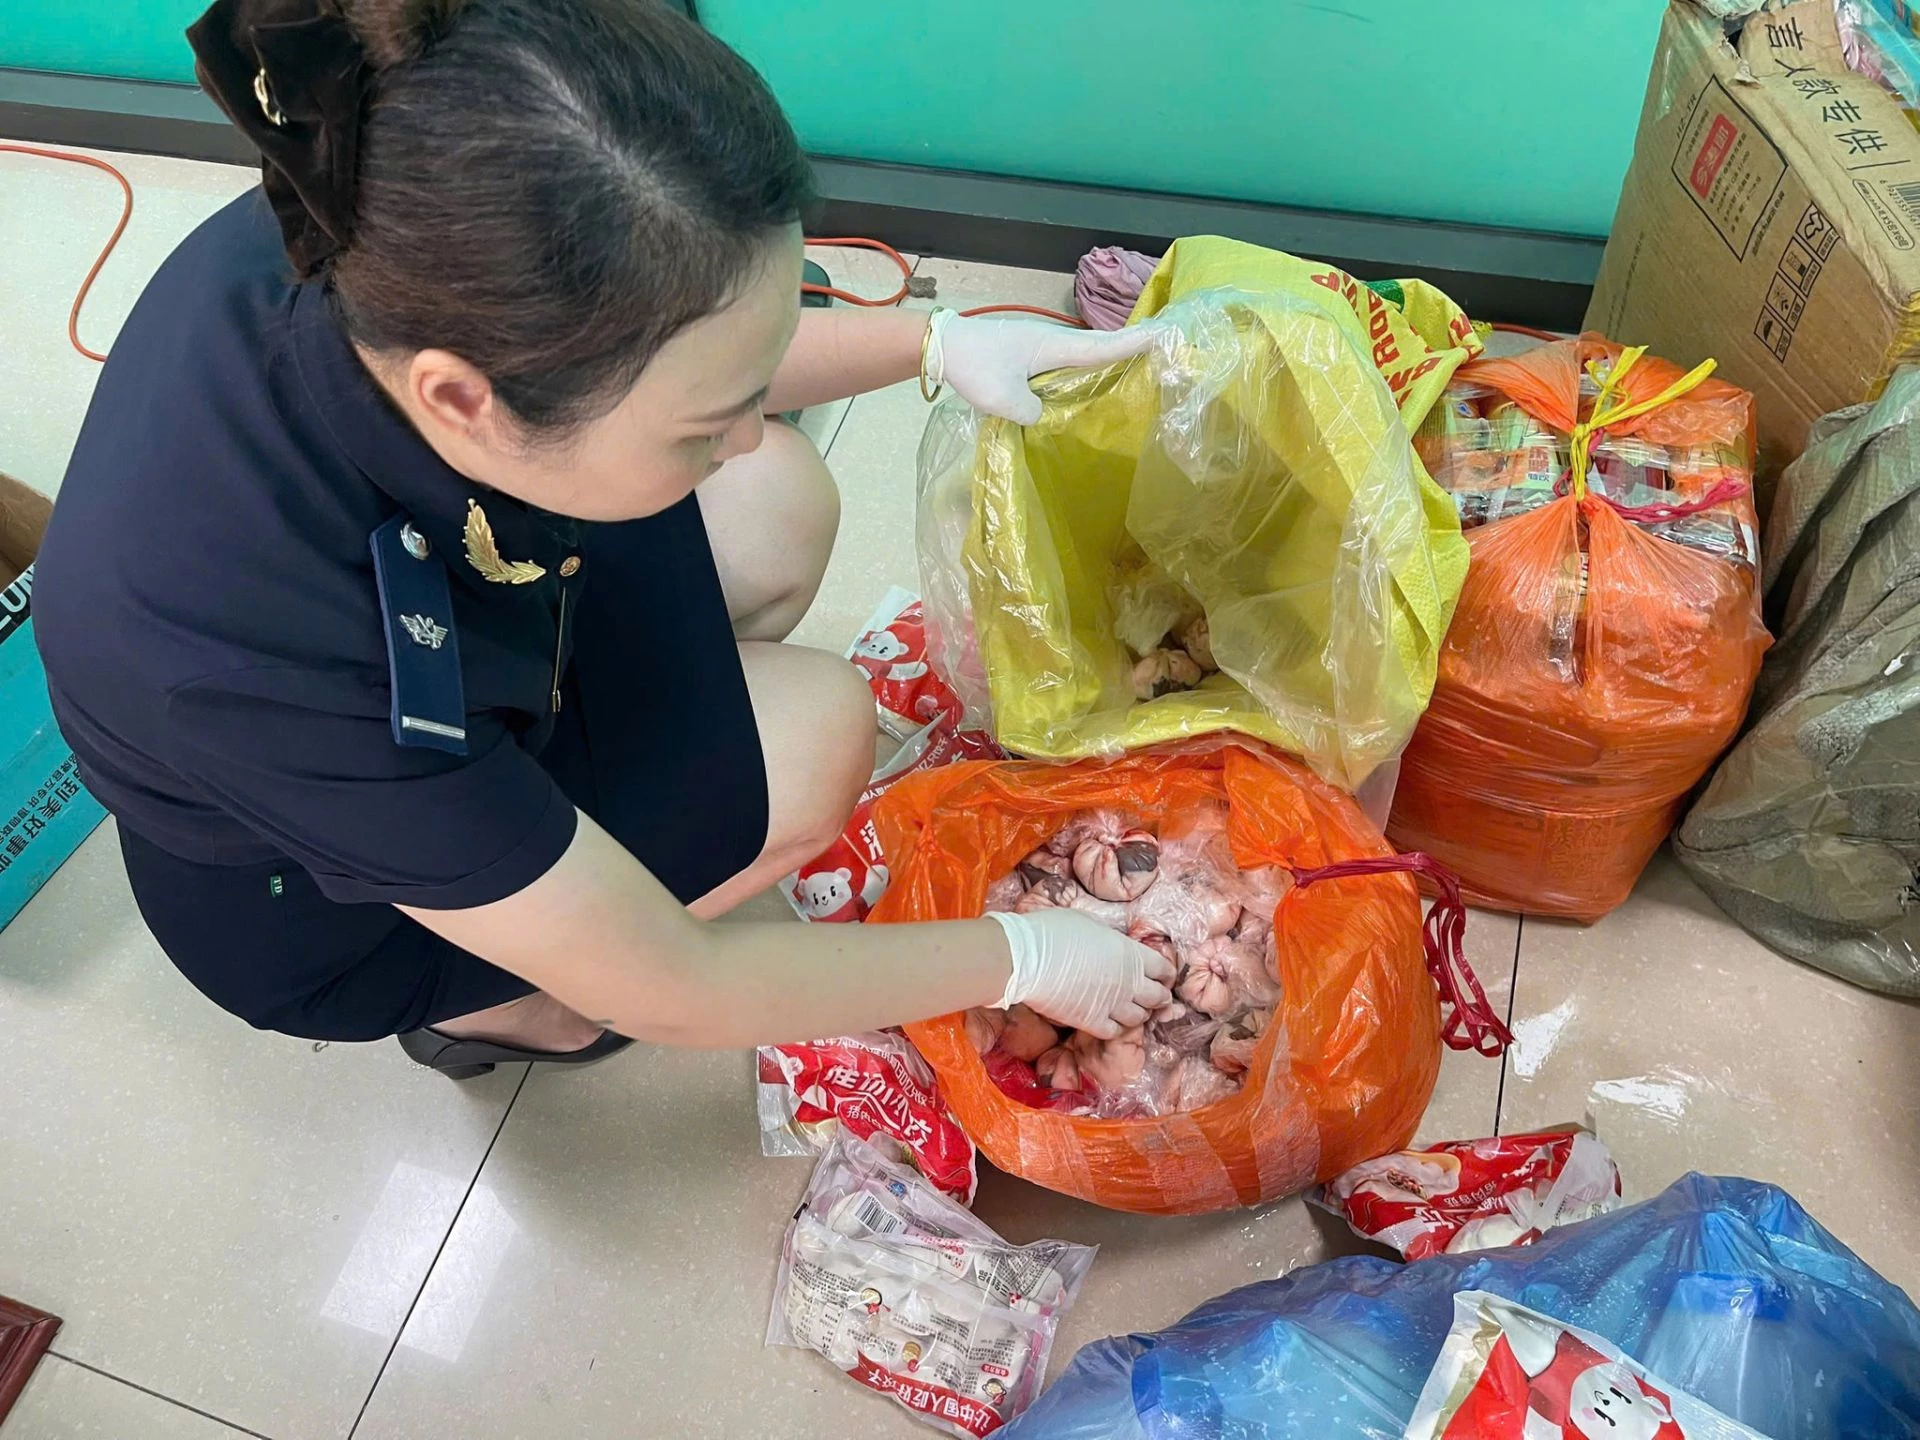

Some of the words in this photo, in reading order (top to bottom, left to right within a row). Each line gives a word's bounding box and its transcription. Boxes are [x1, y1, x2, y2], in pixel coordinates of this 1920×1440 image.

[867, 1366, 992, 1431] 让中国人吃好饺子
